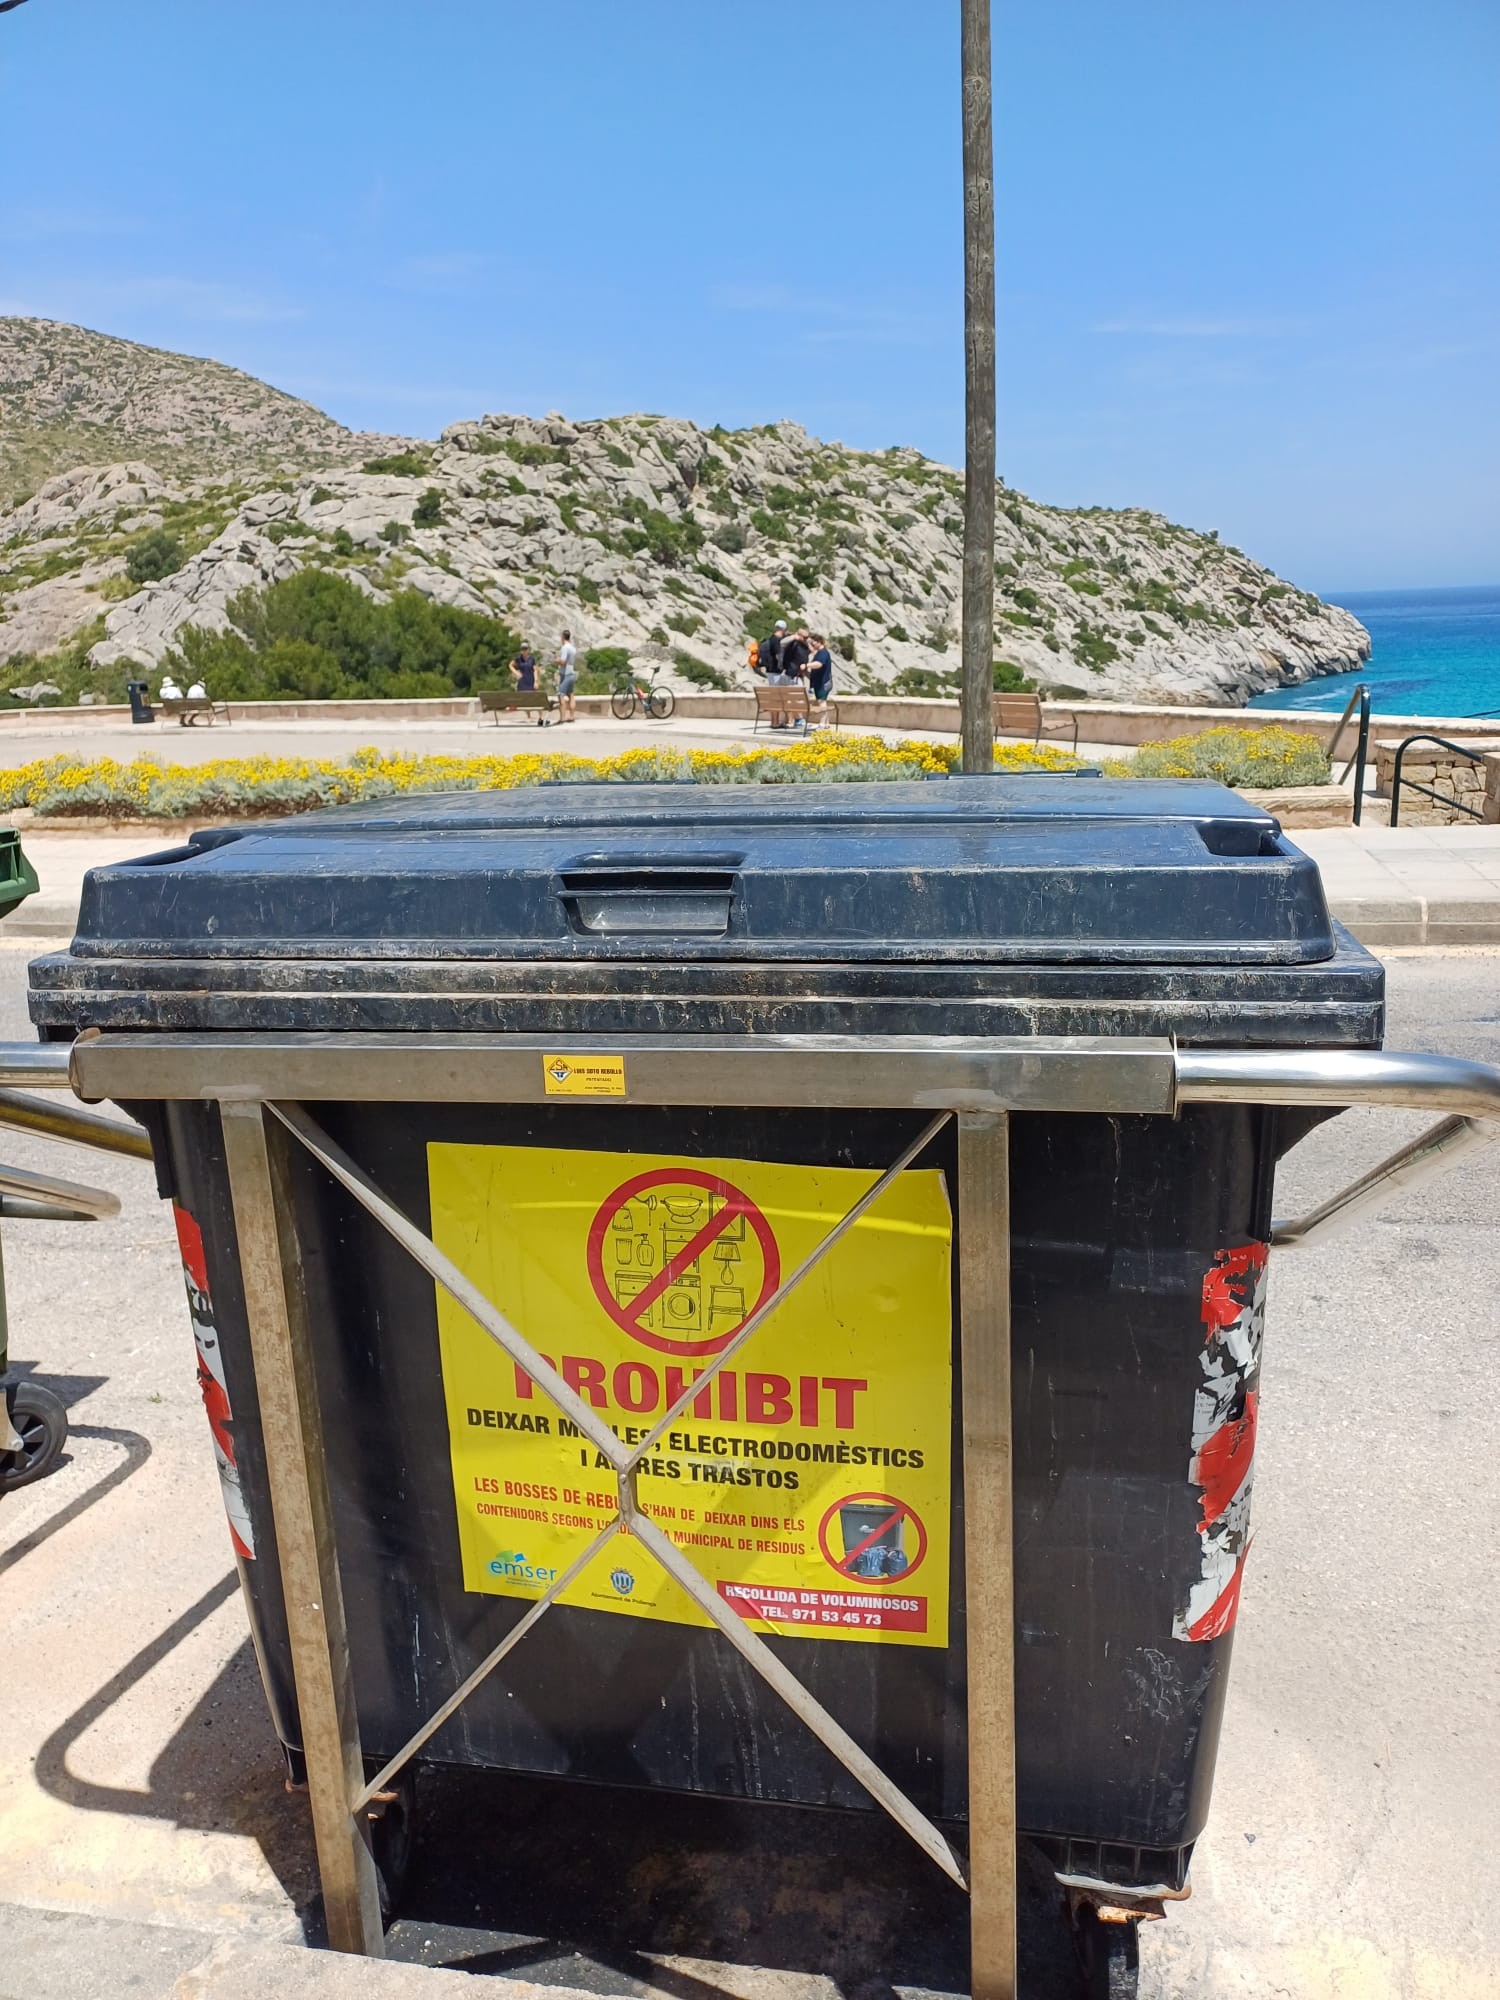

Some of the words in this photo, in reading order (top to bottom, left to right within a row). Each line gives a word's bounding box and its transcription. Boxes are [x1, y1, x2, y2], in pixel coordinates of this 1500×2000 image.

[467, 1408, 550, 1434] DEIXAR
[558, 1418, 661, 1452] MLES,
[669, 1432, 924, 1469] ELECTRODOMÈSTICS
[581, 1449, 587, 1466] I
[595, 1454, 681, 1479] ARES
[688, 1463, 799, 1490] TRASTOS
[475, 1477, 498, 1493] LES
[505, 1481, 558, 1501] BOSSES
[563, 1489, 581, 1504] DE
[642, 1503, 676, 1520] S'HAN
[680, 1508, 695, 1521] DE
[704, 1511, 746, 1527] DEIXAR
[751, 1516, 779, 1530] DINS
[784, 1518, 805, 1531] ELS
[477, 1503, 549, 1523] CONTENIDORS
[552, 1513, 593, 1529] SEGONS
[674, 1531, 735, 1549] MUNICIPAL
[738, 1539, 753, 1551] DE
[756, 1540, 805, 1555] RESIDUS
[491, 1561, 558, 1581] emser
[725, 1586, 797, 1603] RECOLLIDA
[801, 1592, 818, 1605] DE
[821, 1593, 919, 1612] VOLUMINOSOS
[761, 1605, 788, 1619] TEL.
[792, 1609, 816, 1621] 971
[821, 1610, 838, 1622] 53
[843, 1611, 860, 1624] 45
[863, 1613, 882, 1625] 73
